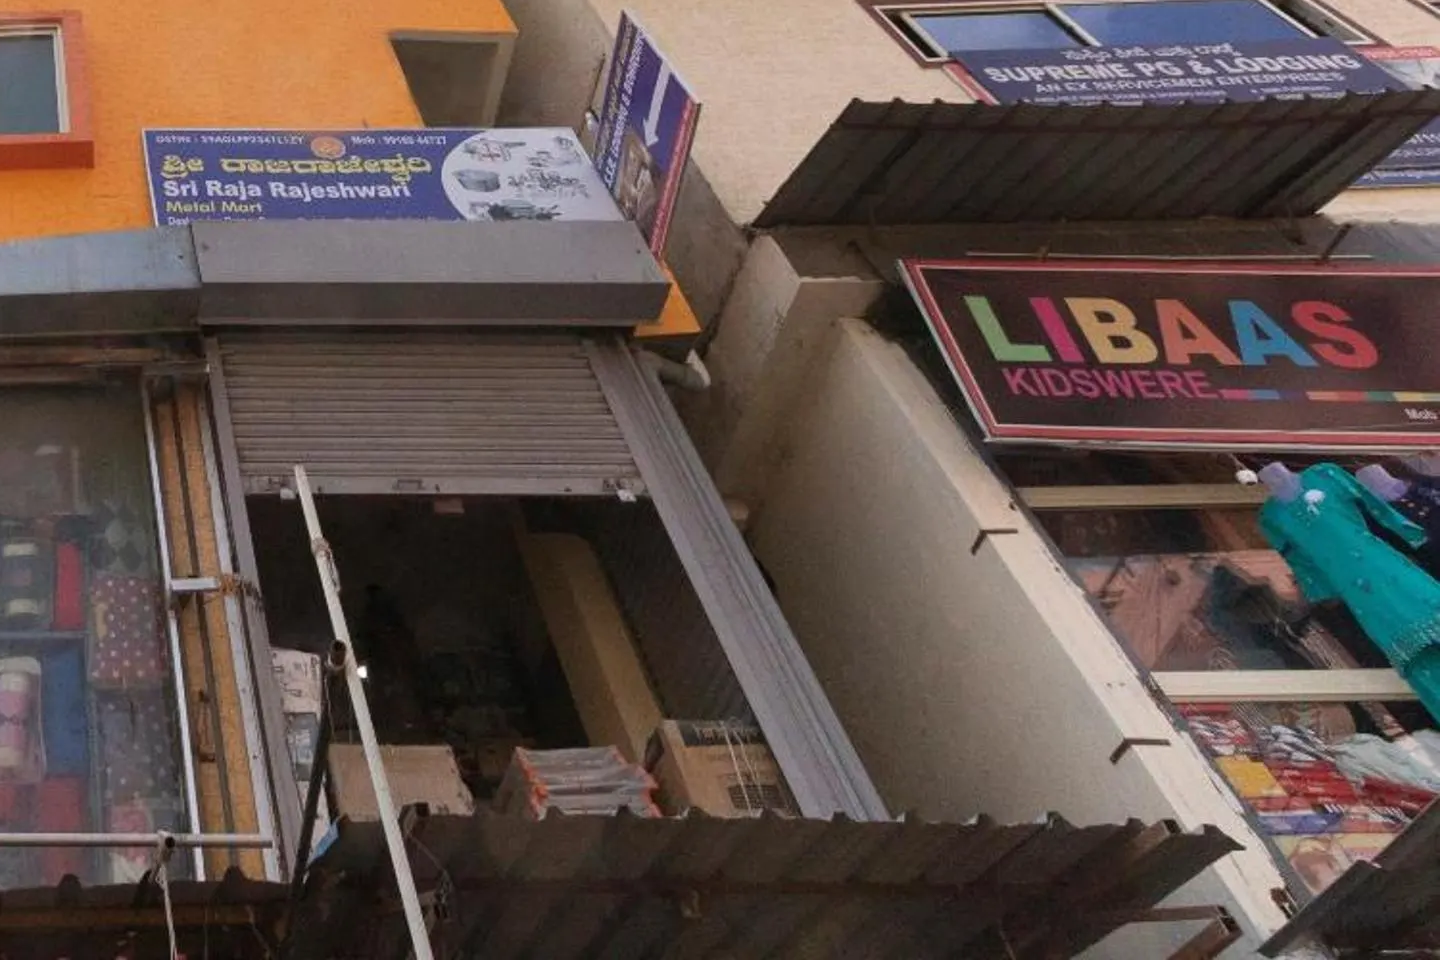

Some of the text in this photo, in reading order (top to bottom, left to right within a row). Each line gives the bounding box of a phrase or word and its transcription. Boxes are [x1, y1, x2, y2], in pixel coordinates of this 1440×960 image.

[983, 53, 1362, 83] SUPREME PG & LODGING
[1035, 71, 1347, 94] AN EX SERVICEMEN ENTERPRISES
[160, 153, 205, 179] ಶ್ರೀ
[163, 180, 412, 203] Sri Raja Rajeshwari
[165, 201, 263, 214] Metal Mart
[962, 295, 1379, 370] LIBAAS
[1001, 367, 1224, 402] KIDSWERE
